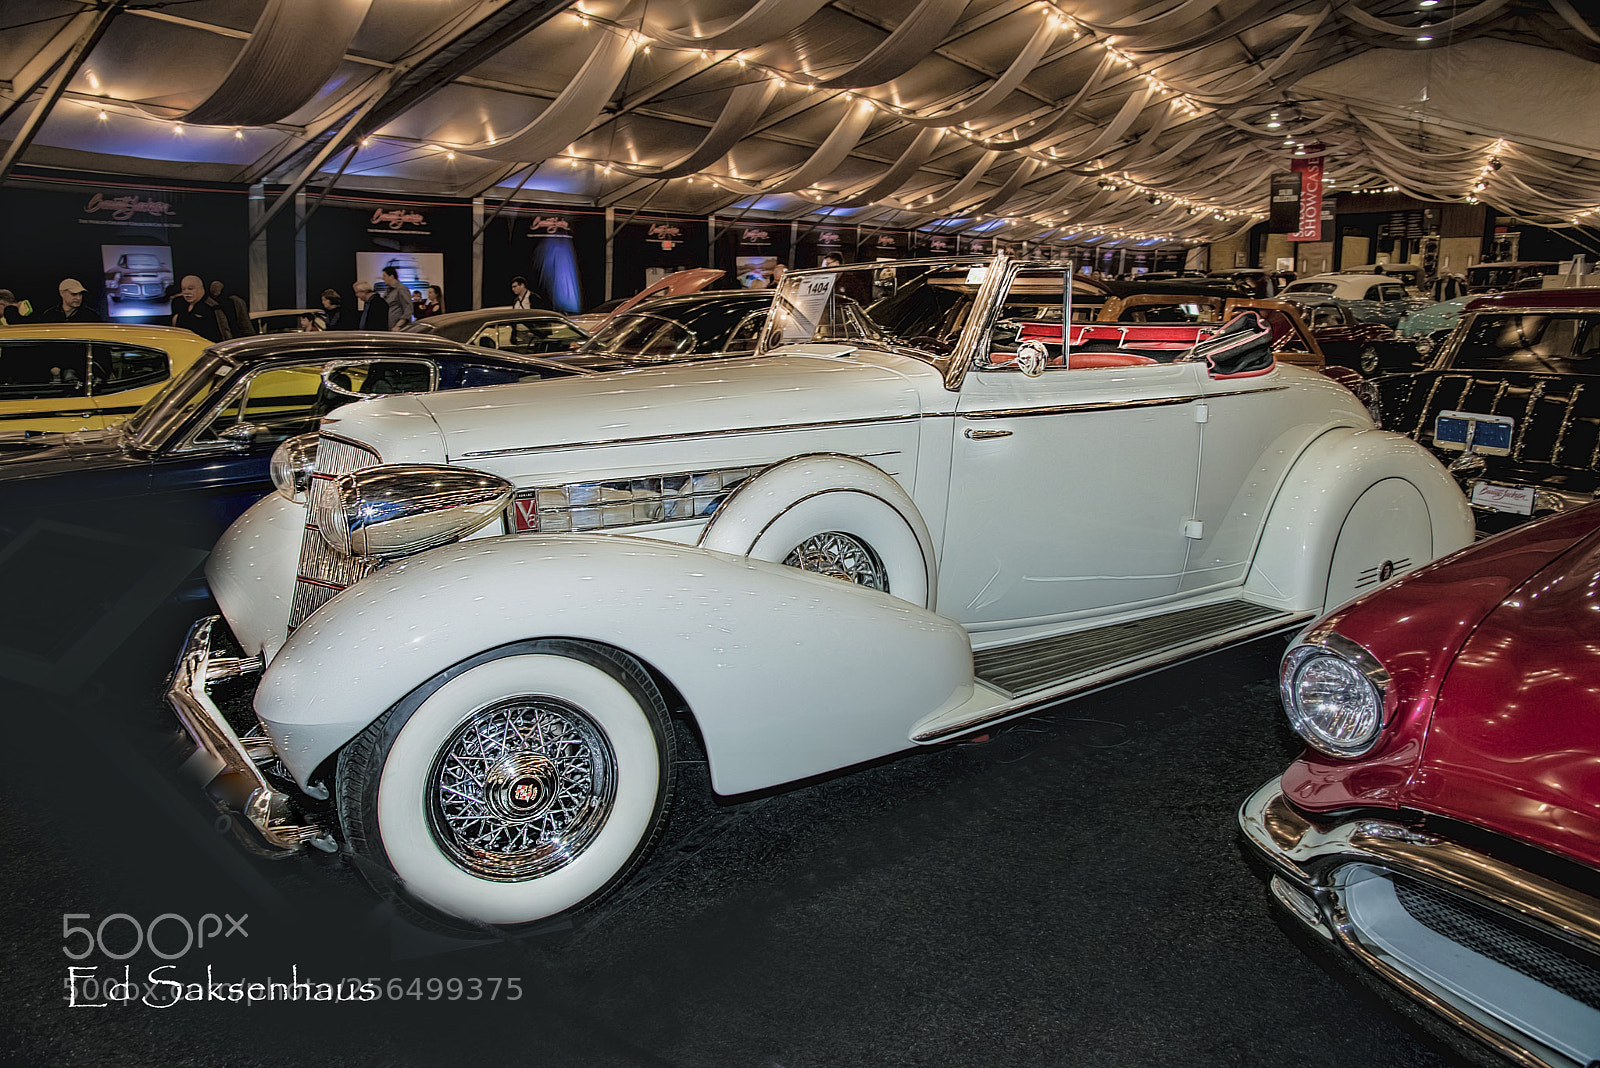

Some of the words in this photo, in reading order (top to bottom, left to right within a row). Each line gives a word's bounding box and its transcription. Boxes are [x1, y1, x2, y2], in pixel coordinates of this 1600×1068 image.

[1305, 157, 1318, 237] SHOWCASE
[807, 281, 829, 295] 1404
[515, 499, 536, 528] V8
